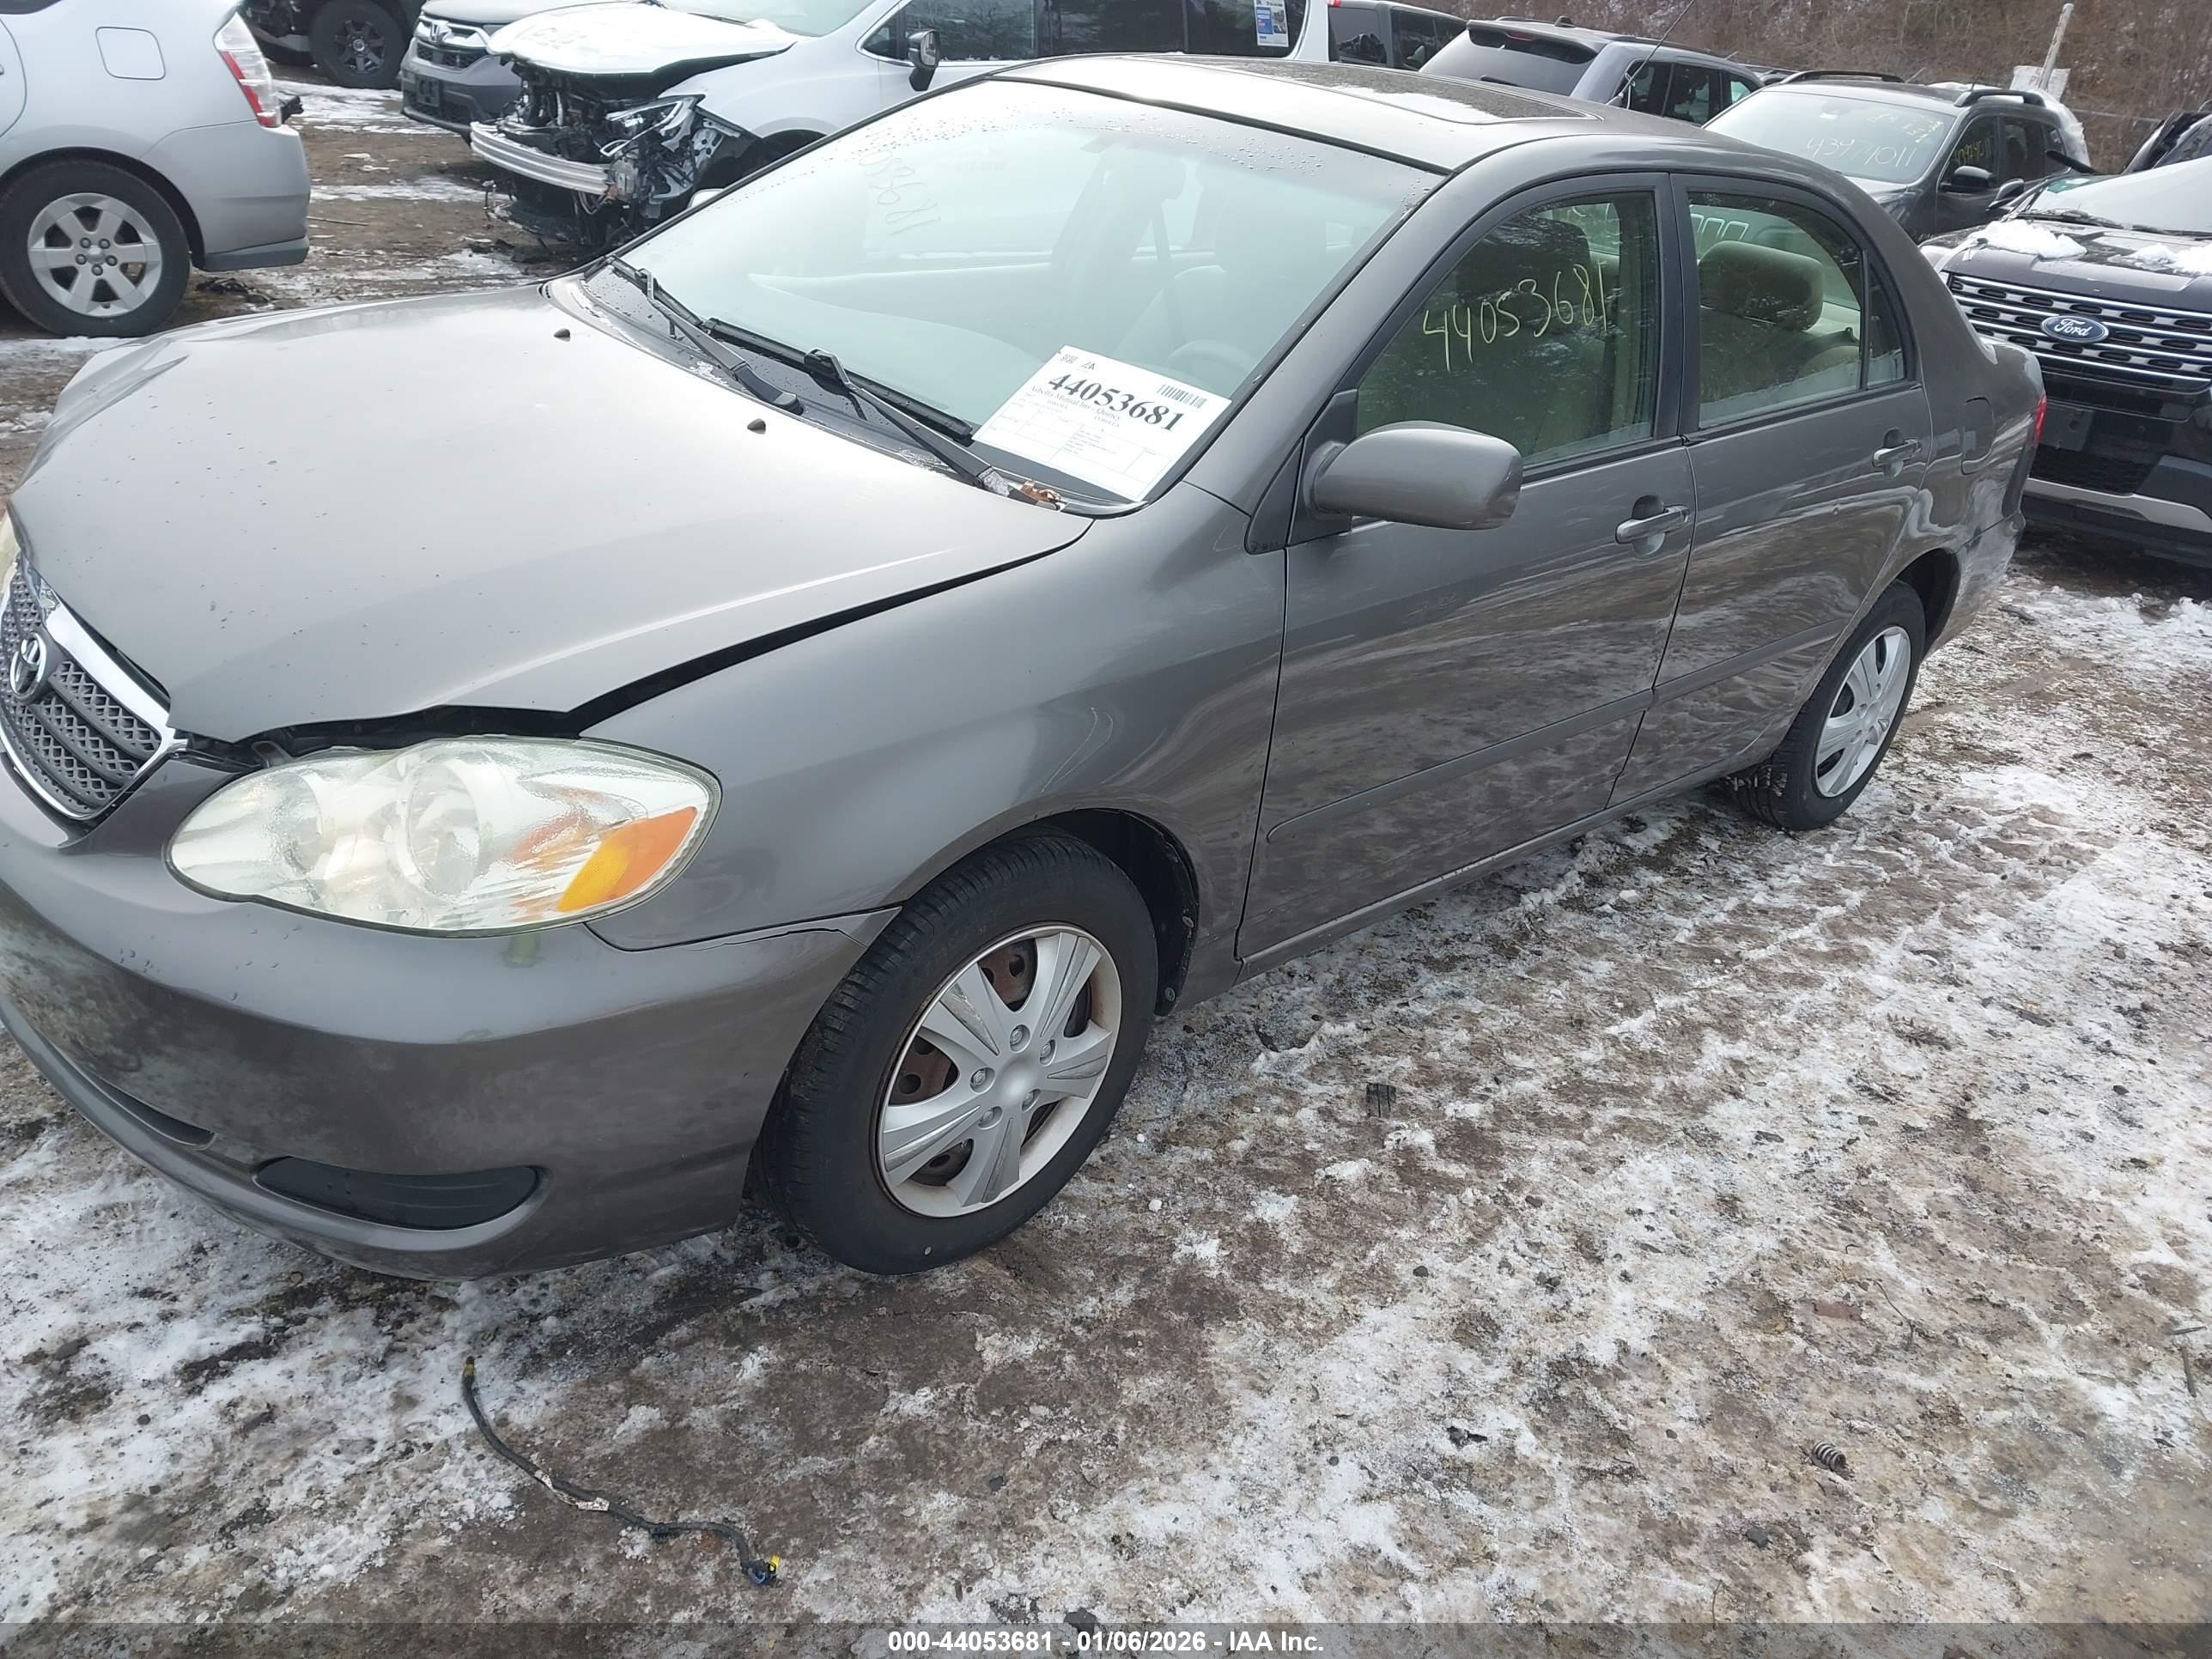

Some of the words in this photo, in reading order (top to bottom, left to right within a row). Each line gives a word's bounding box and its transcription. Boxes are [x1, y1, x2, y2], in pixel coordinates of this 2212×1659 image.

[1423, 260, 1608, 372] 44053681
[2053, 318, 2094, 337] Ford
[1048, 374, 1185, 432] 44053681
